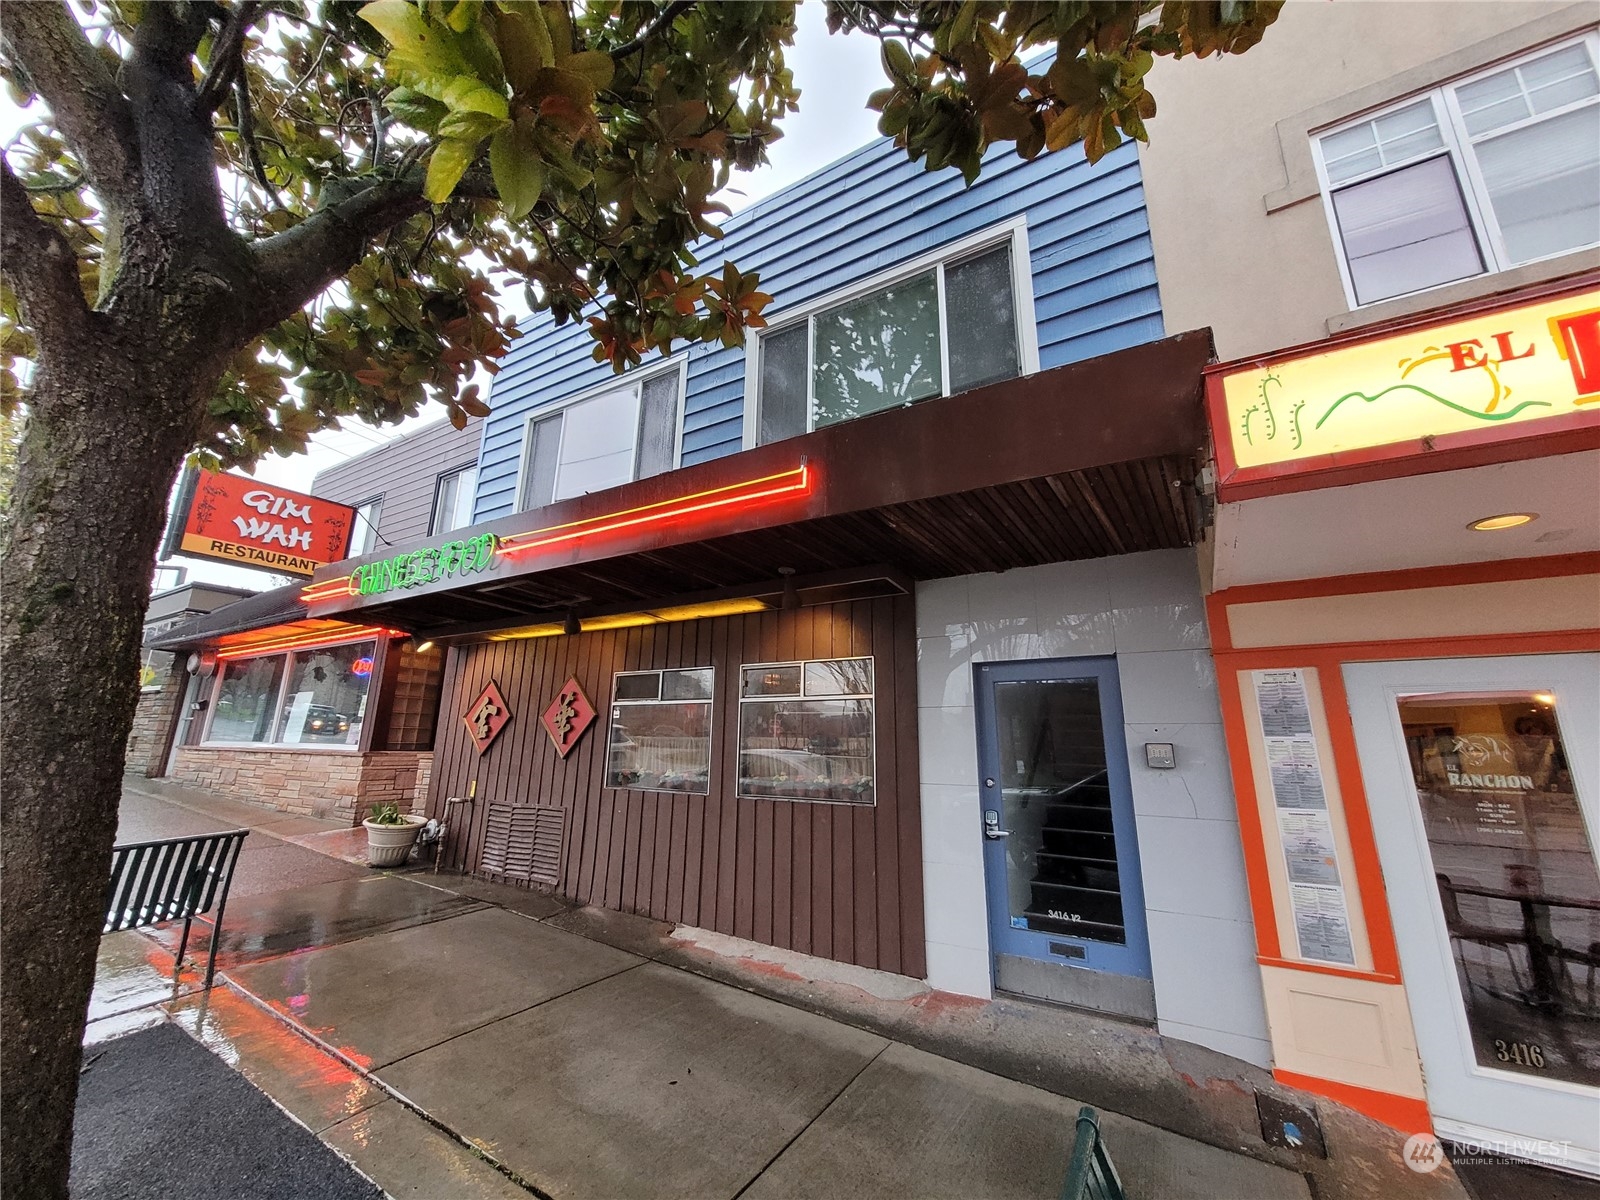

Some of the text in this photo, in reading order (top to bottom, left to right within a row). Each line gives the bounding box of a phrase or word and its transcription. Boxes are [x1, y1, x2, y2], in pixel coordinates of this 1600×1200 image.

[1444, 331, 1535, 373] EL
[243, 491, 313, 524] GIM
[232, 516, 312, 551] WAH
[211, 541, 319, 572] RESTAURANT
[349, 532, 497, 596] CHINESE FOOD
[1447, 772, 1534, 789] RANCHON
[1048, 909, 1069, 920] 3416
[1495, 1039, 1544, 1067] 3416
